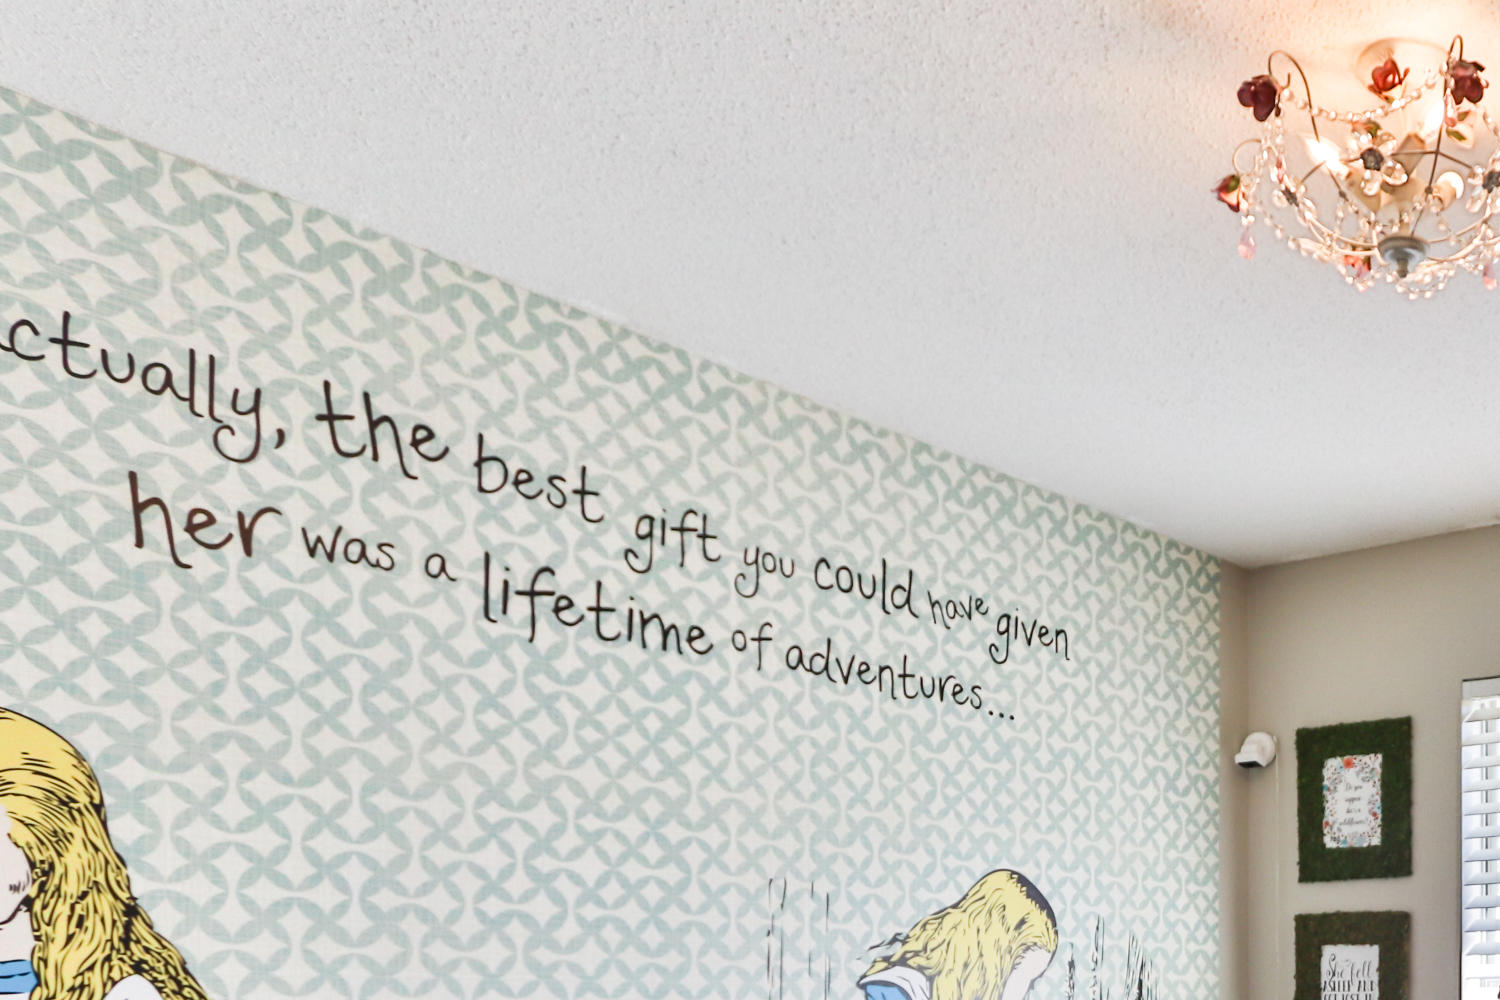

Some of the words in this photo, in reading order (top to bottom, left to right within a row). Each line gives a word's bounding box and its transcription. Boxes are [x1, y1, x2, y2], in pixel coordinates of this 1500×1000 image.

[0, 311, 285, 463] ctually,
[315, 380, 449, 479] the
[474, 433, 603, 523] best
[624, 509, 720, 573] gift
[735, 547, 794, 598] you
[815, 558, 918, 618] could
[928, 592, 988, 629] have
[989, 608, 1069, 664] given
[129, 471, 281, 569] her
[302, 526, 394, 571] was
[425, 554, 456, 581] a
[484, 552, 713, 655] lifetime
[732, 623, 772, 670] of
[786, 637, 1014, 720] adventures...
